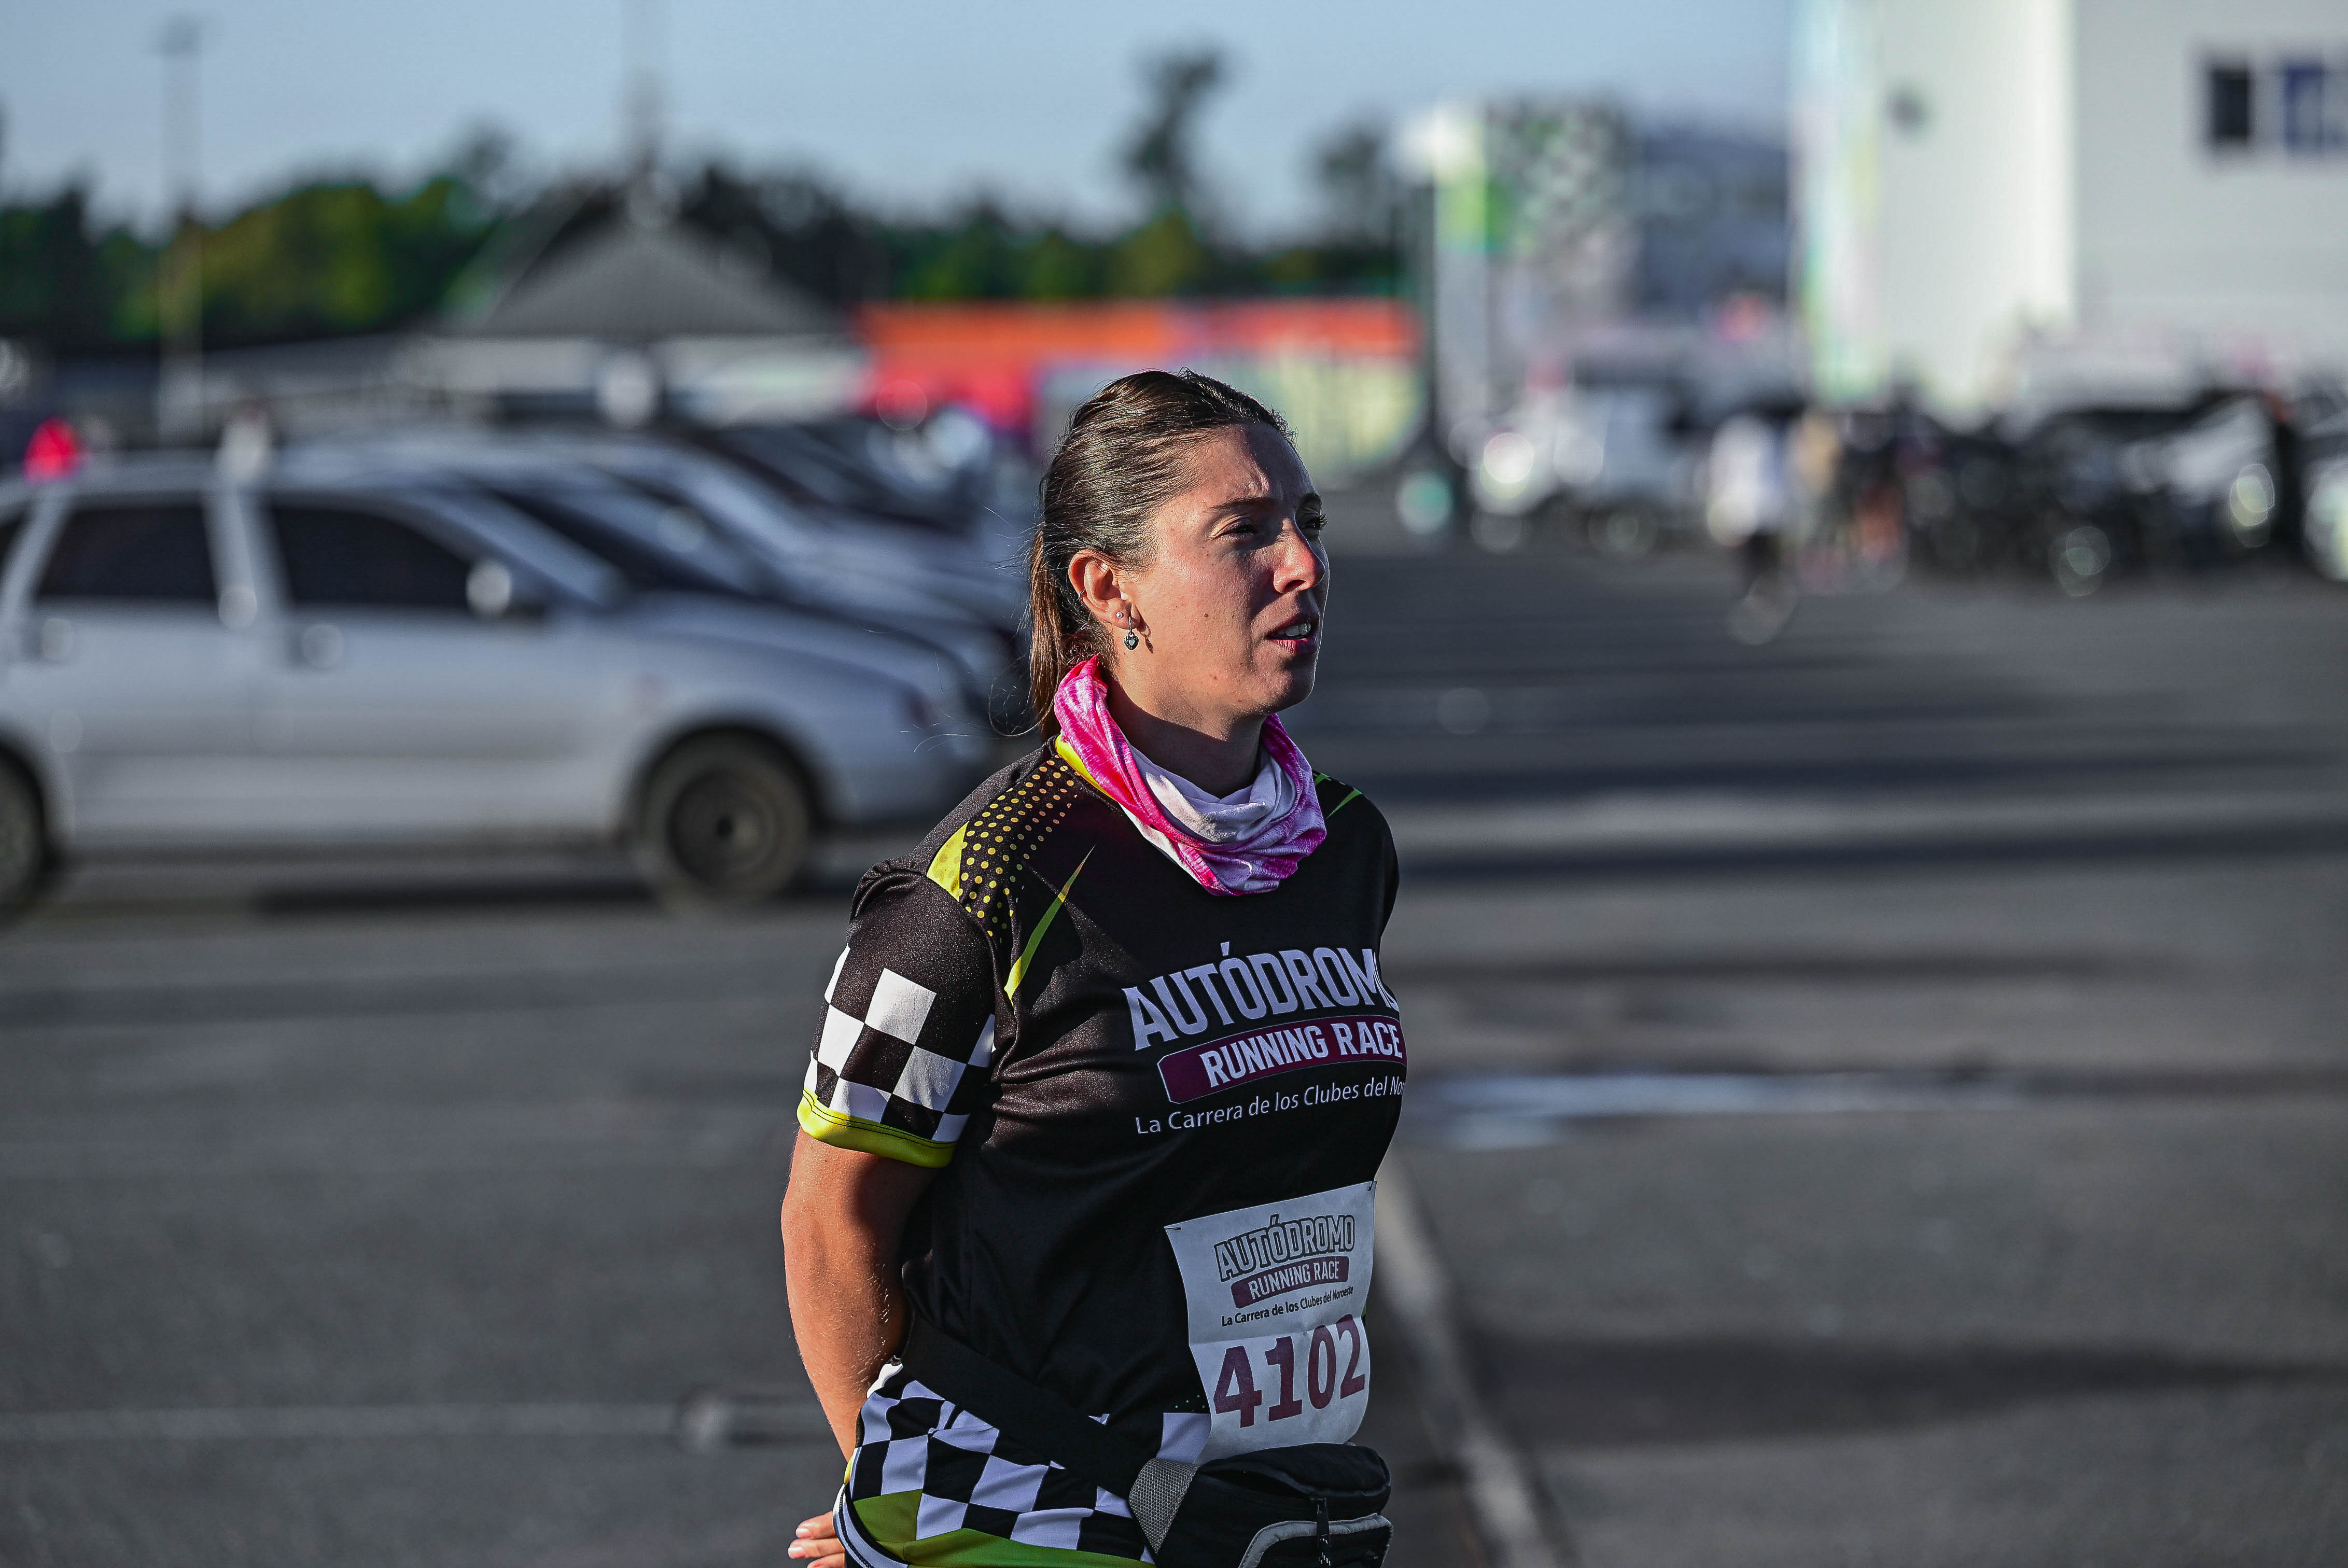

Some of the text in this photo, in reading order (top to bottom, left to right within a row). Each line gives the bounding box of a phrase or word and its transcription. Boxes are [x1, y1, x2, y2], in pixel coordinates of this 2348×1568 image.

[1199, 1023, 1403, 1088] RUNNING RACE
[1135, 1116, 1161, 1134] La
[1168, 1102, 1242, 1130] Carrera
[1249, 1096, 1269, 1115] de
[1275, 1091, 1298, 1111] los
[1304, 1083, 1359, 1105] Clubes
[1364, 1076, 1388, 1097] del
[1213, 1214, 1355, 1283] AUTÓDROMO
[1222, 1285, 1353, 1327] La Carrera de los Clubes del Noroeste
[1248, 1261, 1339, 1300] RUNNING RACE
[1213, 1314, 1365, 1428] 4102
